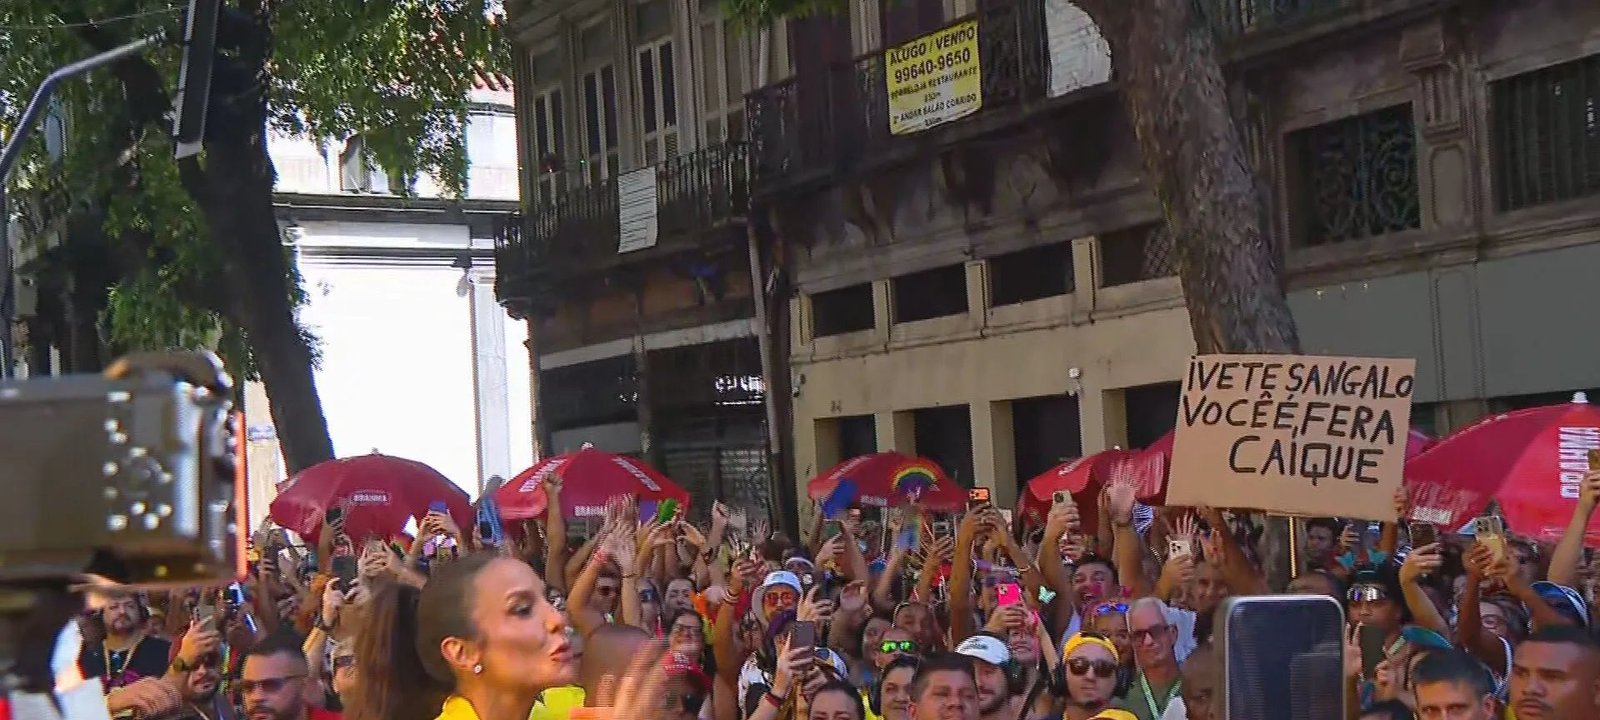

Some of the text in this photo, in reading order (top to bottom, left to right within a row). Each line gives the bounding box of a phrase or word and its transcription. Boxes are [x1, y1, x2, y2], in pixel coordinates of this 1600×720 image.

[890, 42, 927, 66] ALUGO
[935, 26, 976, 50] VENDO
[894, 47, 971, 84] 99640-9650
[928, 65, 977, 88] RESTAURANTE
[900, 108, 922, 123] ANDAR
[946, 93, 977, 110] CORRIDO
[1284, 361, 1413, 400] SANGALO
[1182, 390, 1273, 428] VOCÊ
[1300, 401, 1396, 445] FERA
